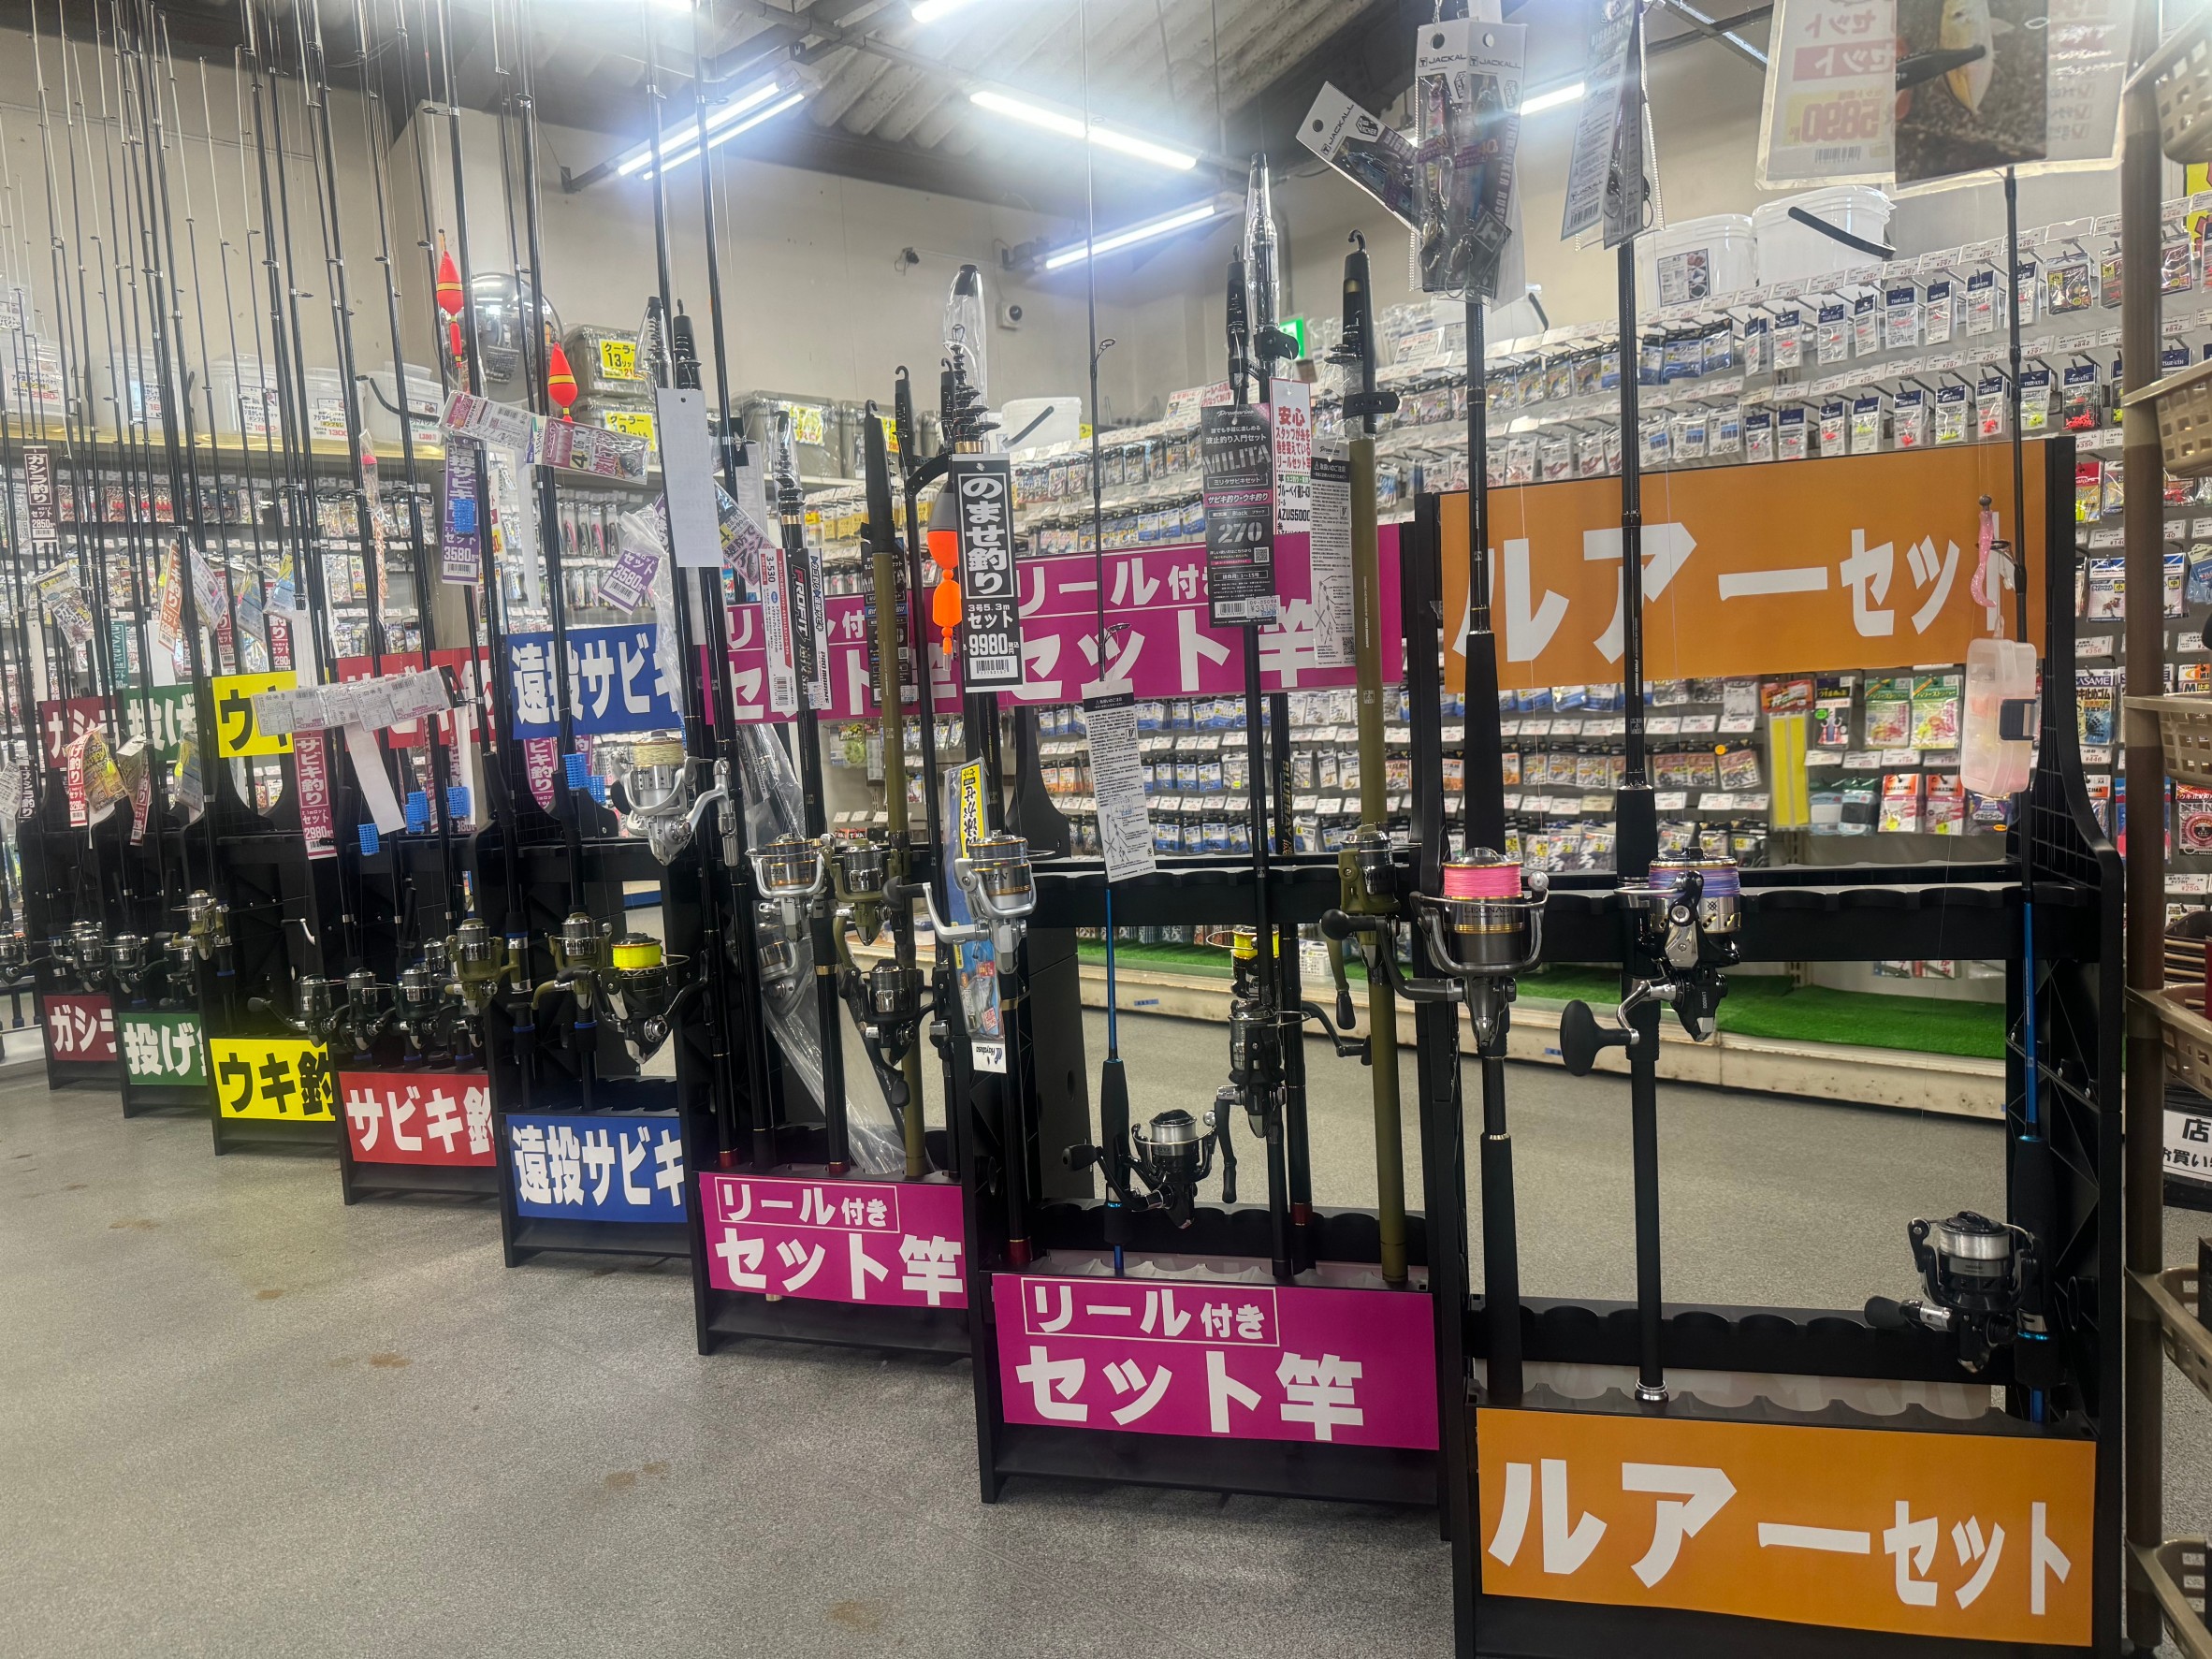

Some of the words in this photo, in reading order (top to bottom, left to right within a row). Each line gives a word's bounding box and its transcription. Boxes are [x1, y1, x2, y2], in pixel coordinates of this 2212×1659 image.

[1429, 54, 1466, 64] JACKAL
[1479, 59, 1521, 69] JACKALL
[1329, 104, 1354, 146] JACKALL
[608, 353, 635, 369] 13リッ
[610, 416, 645, 426] クーラー
[1278, 406, 1306, 426] 安心
[1206, 433, 1267, 444] 波止釣り入門セット
[1276, 428, 1310, 443] スタッフが糸を
[28, 455, 49, 503] ガシラ釣り
[1208, 493, 1269, 503] サビキ釣り・ウキ釣り
[31, 508, 52, 517] セット
[32, 519, 51, 529] 2850
[962, 477, 1008, 595] のませ釣り
[1218, 522, 1262, 543] 270
[444, 547, 471, 560] 3580
[624, 552, 653, 575] セット
[613, 564, 643, 589] 3580
[766, 556, 776, 583] 3-530
[810, 563, 820, 590] カゴ釣り
[1018, 557, 1209, 616] リール付
[1452, 512, 2014, 663] ルアーセット
[794, 569, 808, 636] PROFIT
[813, 596, 824, 632] 遠投サビキ
[968, 604, 1010, 612] 3号5.3m
[968, 612, 1013, 629] セット
[968, 633, 1008, 655] 9980
[297, 739, 325, 805] サビキ釣り
[303, 815, 328, 825] セット
[304, 826, 327, 839] 2980
[124, 1023, 207, 1076] 投げ
[219, 1052, 335, 1115] ウキ釣
[346, 1085, 494, 1155] サビキ釣
[2182, 1118, 2212, 1142] 店
[512, 1125, 685, 1207] 遠投サビキ
[723, 1183, 889, 1228] リール付き
[715, 1228, 964, 1305] セット竿
[1034, 1285, 1265, 1340] リール付き
[1015, 1346, 1364, 1441] セット竿
[1488, 1458, 2072, 1616] ルアーセット
